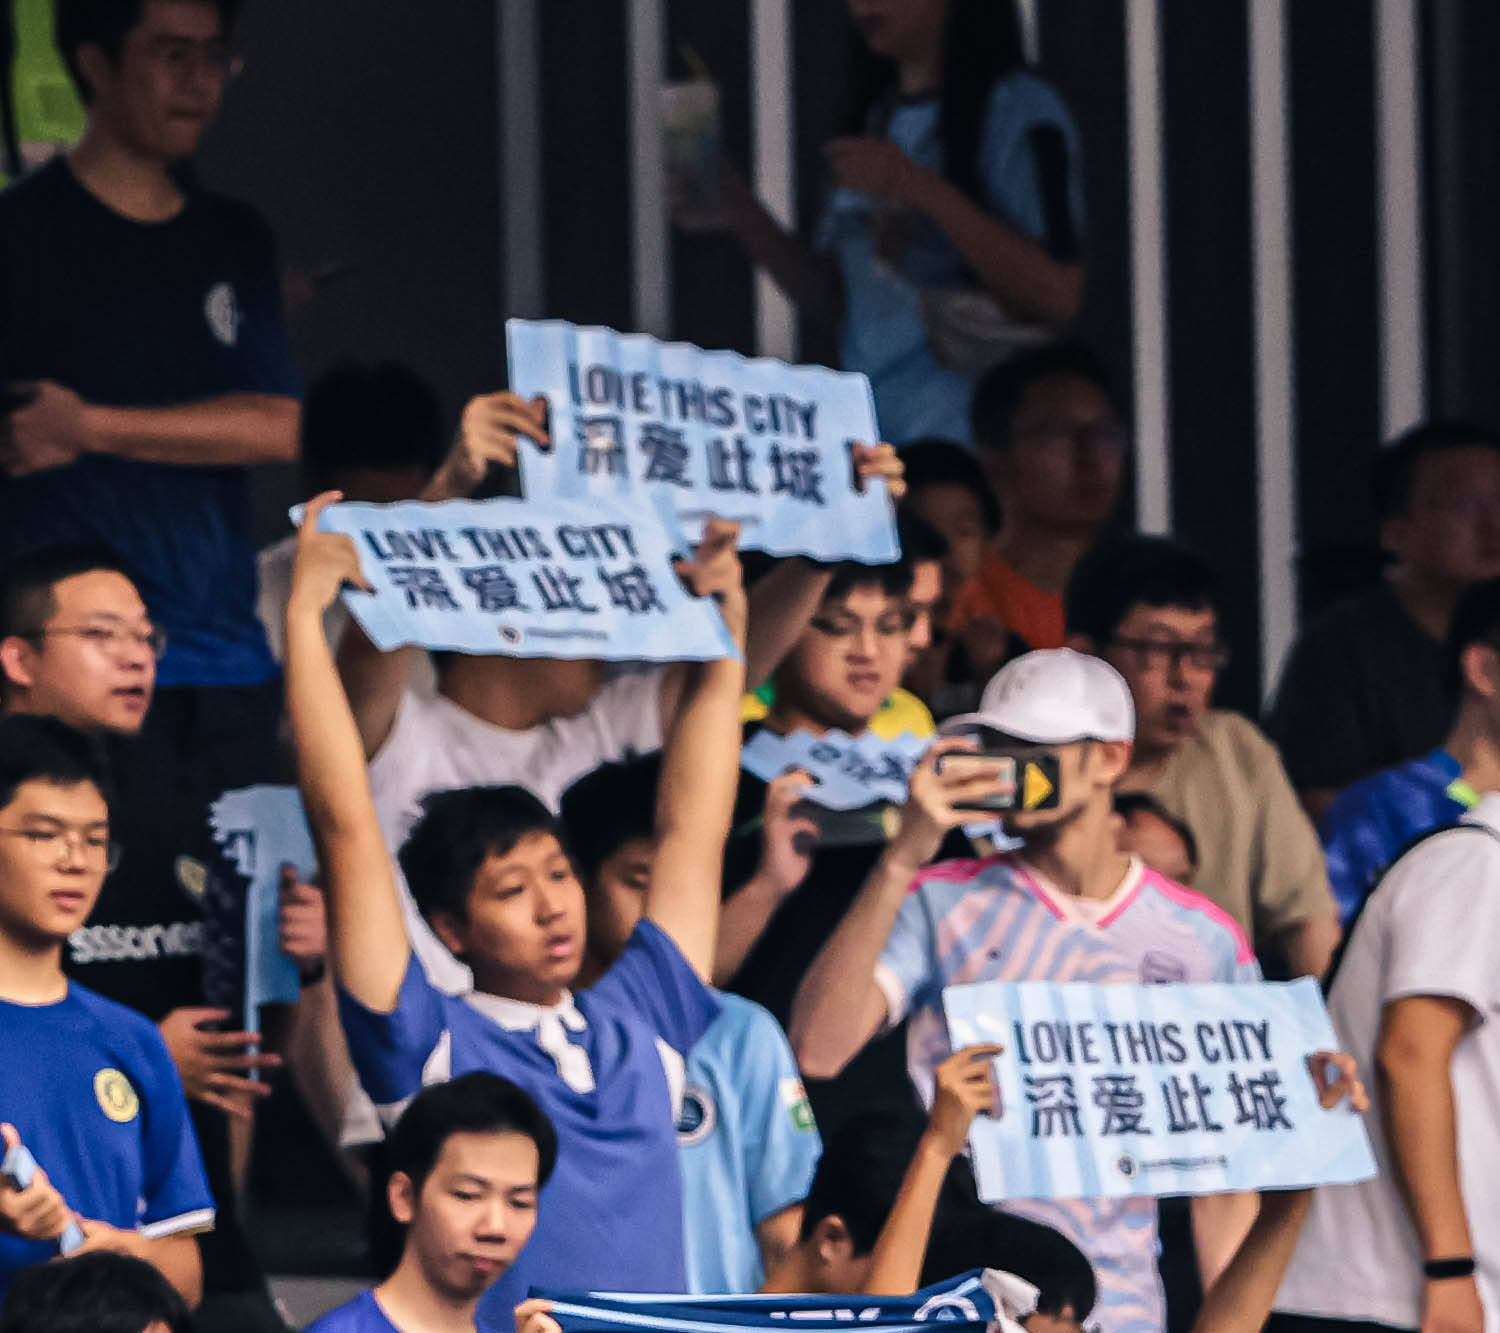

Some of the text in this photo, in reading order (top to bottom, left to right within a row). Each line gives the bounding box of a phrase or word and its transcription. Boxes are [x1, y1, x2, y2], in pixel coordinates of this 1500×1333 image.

[362, 524, 639, 561] LOVE THIS CITY
[386, 563, 667, 615] 深爱此城
[1013, 1020, 1272, 1066] LOVE THIS CITY
[1023, 1070, 1294, 1140] 深爱此城
